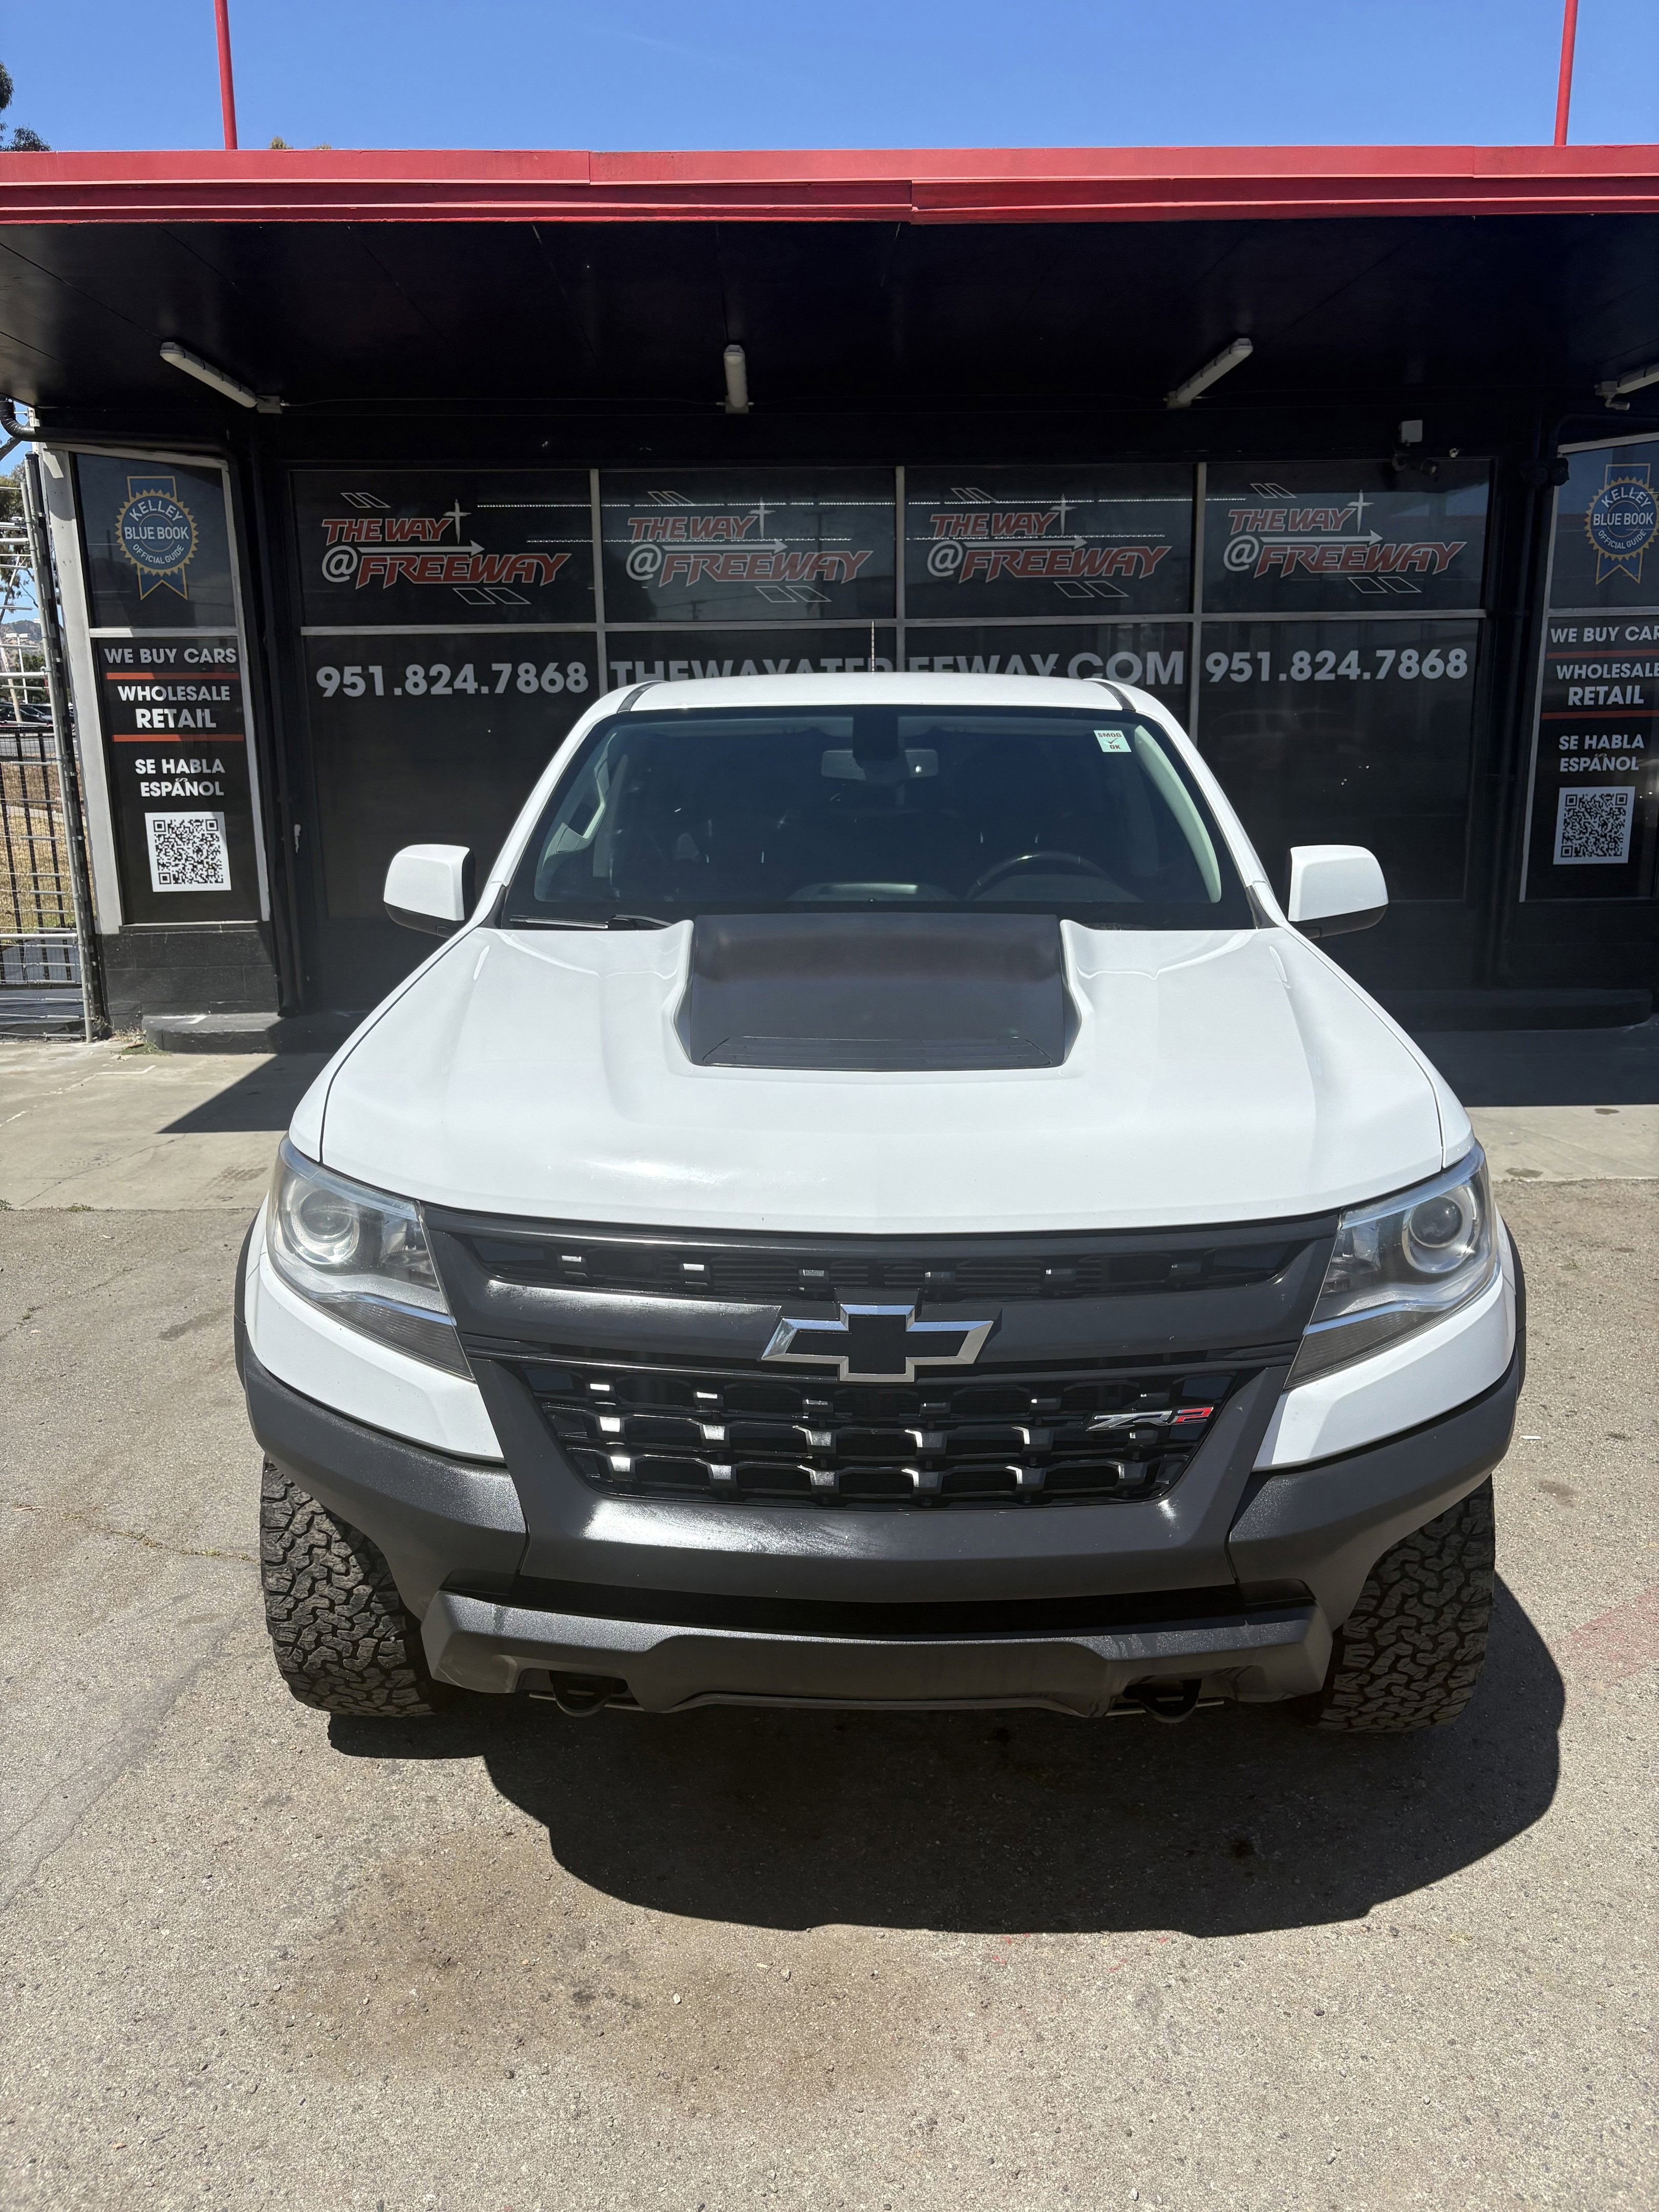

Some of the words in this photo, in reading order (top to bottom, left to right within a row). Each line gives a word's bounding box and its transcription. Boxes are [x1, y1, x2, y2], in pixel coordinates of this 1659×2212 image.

[1601, 486, 1652, 508] KELLEY
[129, 499, 184, 522] KELLEY
[1592, 513, 1622, 526] BLUE
[1623, 512, 1654, 525] BOOK
[124, 526, 155, 540] BLUE
[157, 526, 190, 540] BOOK
[1598, 529, 1626, 549] OFFICIAL
[1626, 529, 1647, 548] GUIDE
[133, 543, 165, 564] OFFICIAL
[164, 544, 184, 563] GUIDE
[1550, 627, 1578, 643] WE
[1583, 626, 1620, 643] BUY
[1624, 625, 1659, 641] CAR
[104, 648, 134, 664] WE
[139, 648, 177, 664] BUY
[183, 648, 237, 664] CARS
[1205, 648, 1468, 684] 951.824.7868
[316, 662, 589, 698] 951.824.7868
[1556, 662, 1659, 679] WHOLESALE
[117, 686, 230, 701] WHOLESALE
[1567, 685, 1644, 706] RETAIL
[135, 708, 217, 729] RETAIL
[1558, 735, 1579, 751] SE
[1584, 733, 1645, 750] HABLA
[135, 758, 156, 774] SE
[162, 758, 225, 774] HABLA
[1559, 752, 1640, 773] ESPAÑOL
[140, 777, 225, 797] ESPAÑOL
[1085, 1407, 1214, 1432] ZR2
